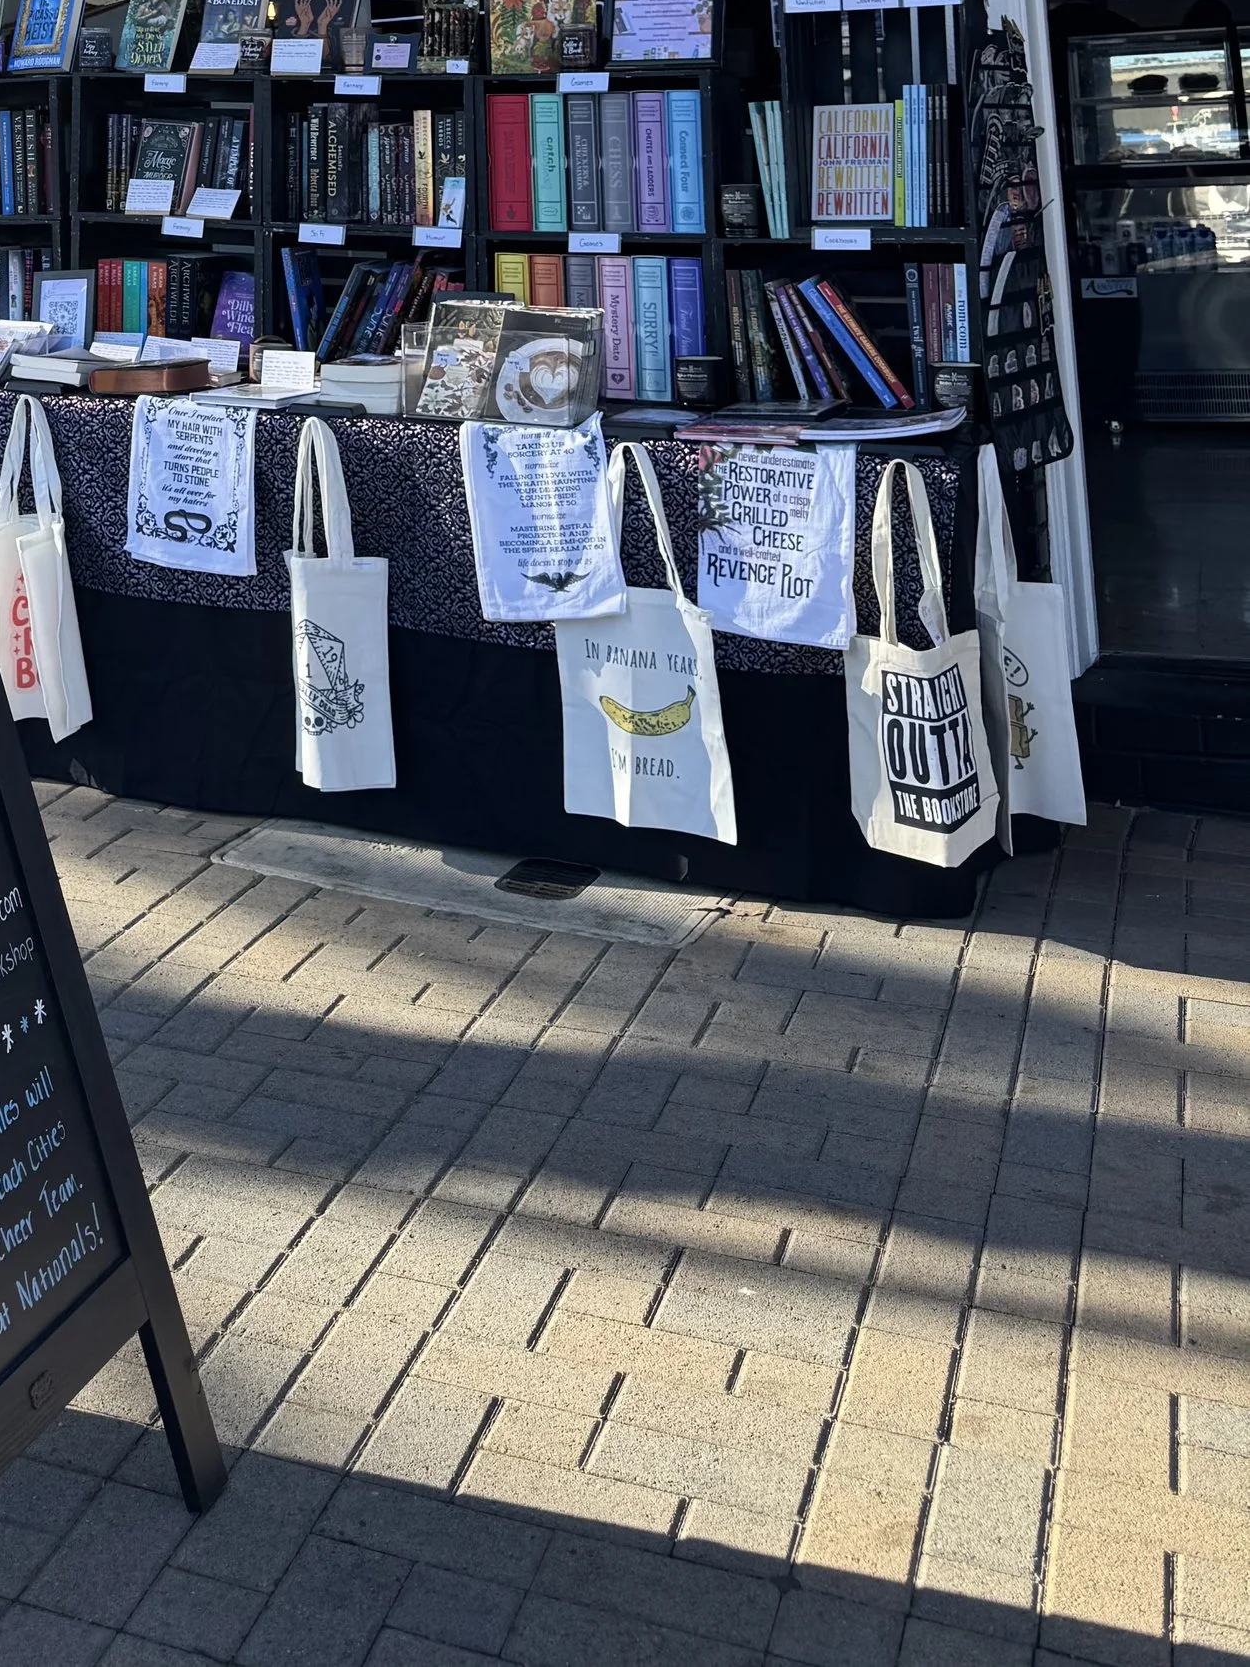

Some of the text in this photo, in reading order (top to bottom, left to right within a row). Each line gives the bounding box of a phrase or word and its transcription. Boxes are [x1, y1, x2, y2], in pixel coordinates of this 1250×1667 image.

[819, 110, 889, 134] CALIFORNIA
[26, 115, 35, 160] FLESH
[818, 136, 889, 160] CALIFORNIA
[328, 120, 337, 196] ALCHEMISED
[609, 136, 623, 188] CHESS
[679, 131, 690, 193] Connect Four
[818, 166, 889, 190] REWRITTEN
[818, 192, 889, 216] REWRITTEN
[579, 238, 603, 247] Games
[169, 260, 179, 324] ARCHWILDE
[181, 262, 191, 325] ARCHWILDE
[610, 294, 621, 335] Mystery
[167, 419, 222, 436] MY HAIR WITH
[168, 407, 188, 416] Once
[196, 414, 224, 423] replace
[176, 431, 213, 445] SERPENTS
[186, 445, 211, 457] develop
[164, 461, 219, 478] TURNS PEOPLE
[195, 456, 211, 464] that
[738, 452, 815, 470] never underestimate
[172, 473, 209, 487] TO STONE
[715, 462, 814, 489] THE RESTORATIVE
[168, 496, 208, 507] my haters
[174, 486, 186, 494] all
[203, 491, 216, 500] for
[724, 480, 773, 507] POWER
[773, 492, 781, 502] of
[783, 495, 788, 503] a
[731, 501, 788, 527] GRILLED
[790, 508, 808, 521] melty
[753, 526, 804, 552] CHEESE
[719, 545, 732, 554] and
[738, 547, 781, 562] well-crafted
[707, 553, 814, 598] REVENGE PLOT
[585, 639, 599, 660] IN
[606, 644, 657, 671] BANANA
[886, 666, 965, 720] STRAIGHT
[887, 712, 975, 786] OUTTA
[611, 747, 680, 779] I'M BREAD.
[896, 783, 978, 825] THE BOOKSTORE
[26, 1065, 55, 1108] will
[26, 1119, 67, 1174] Cities
[37, 1176, 83, 1221] Team.
[16, 1202, 104, 1311] Nationals!
